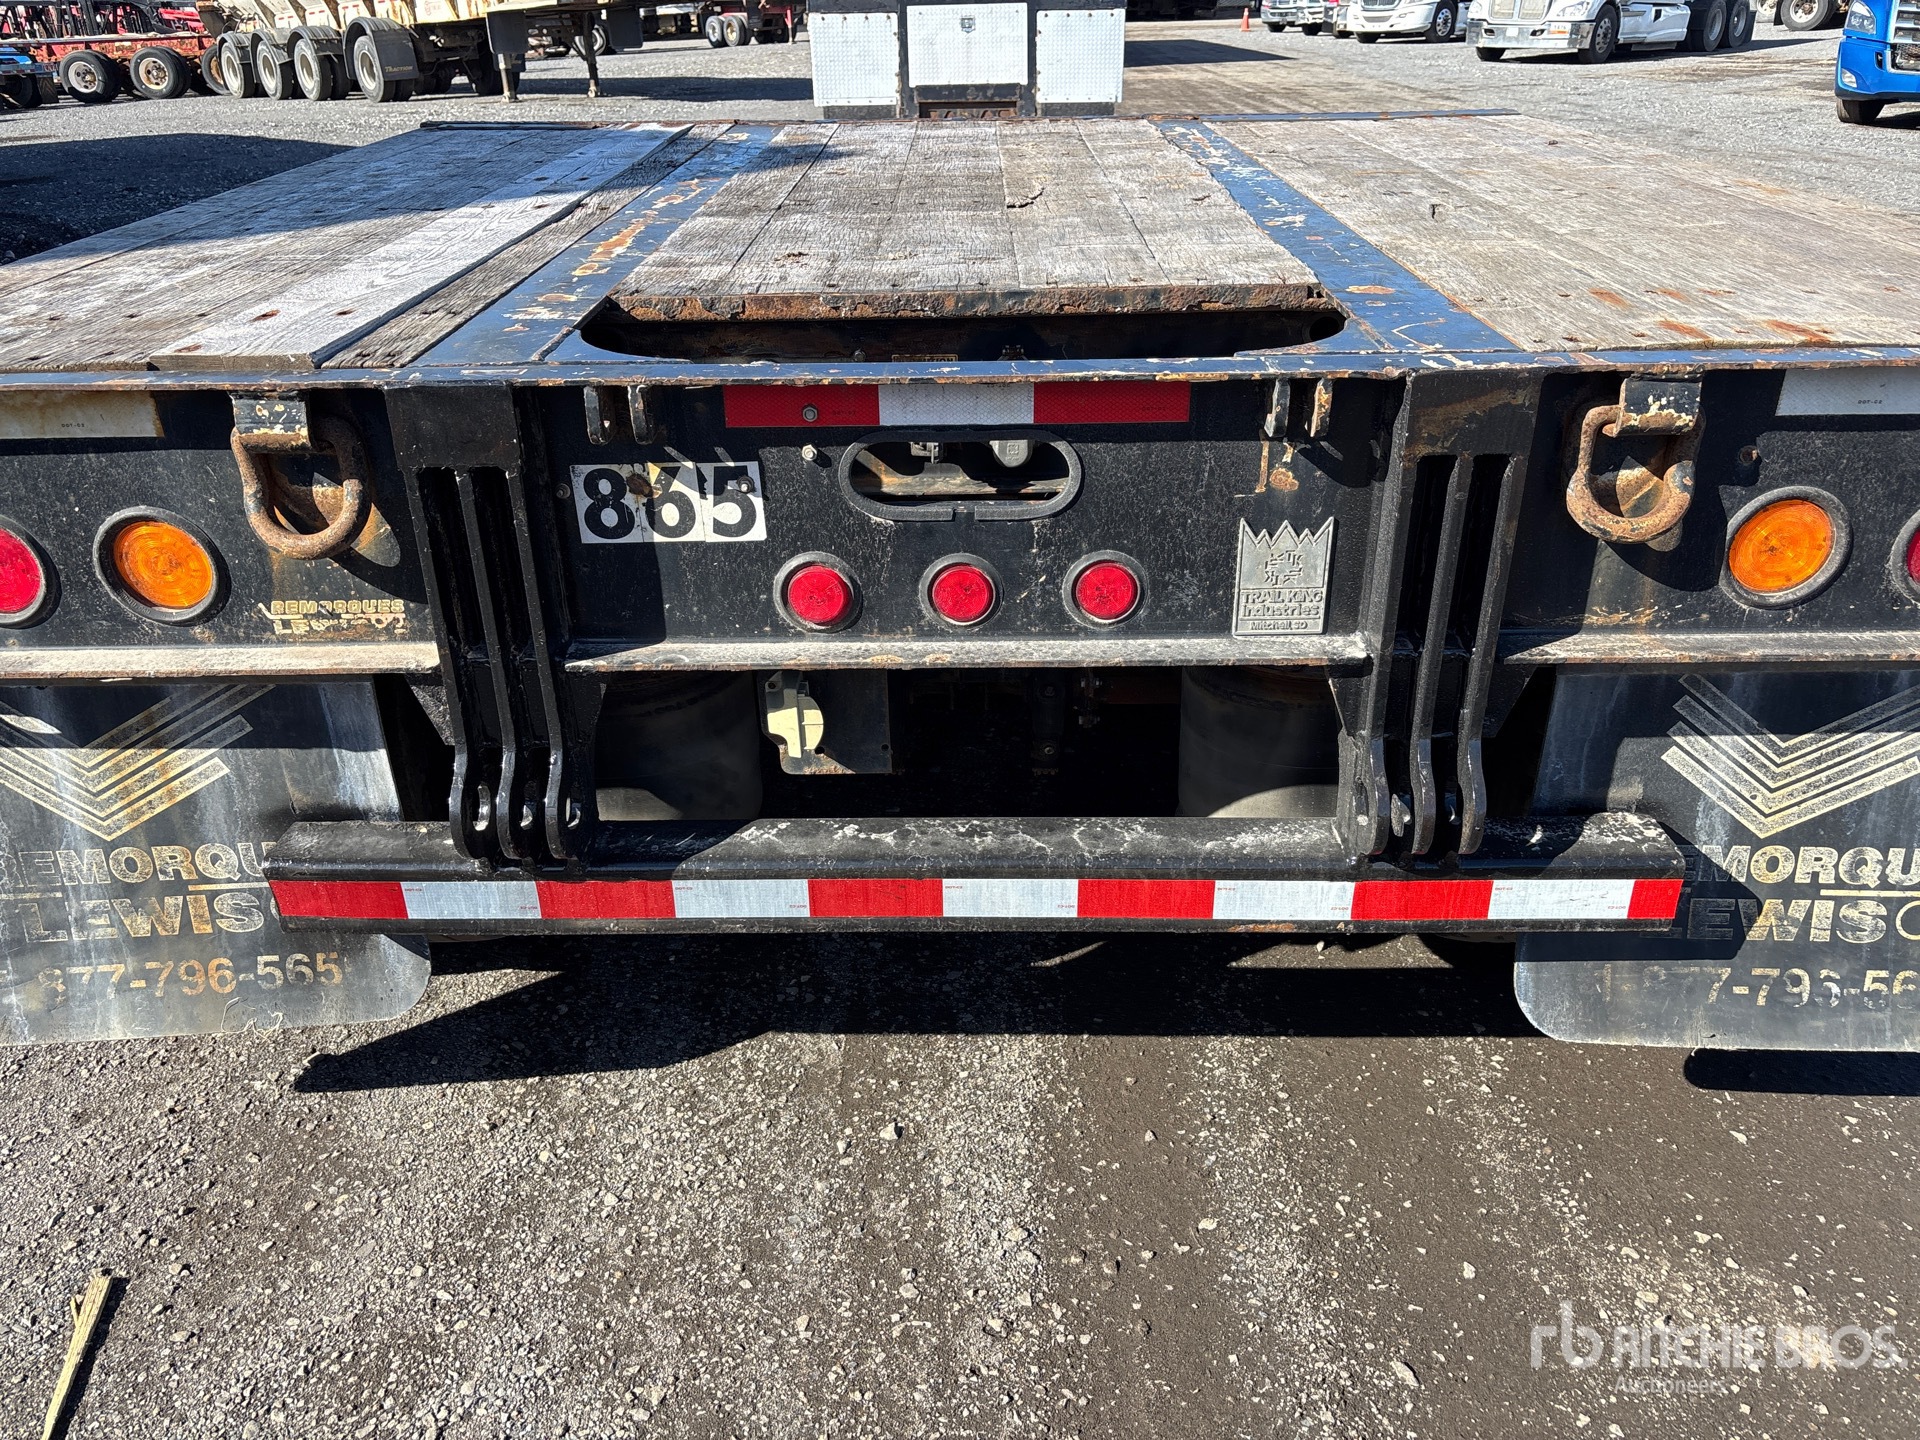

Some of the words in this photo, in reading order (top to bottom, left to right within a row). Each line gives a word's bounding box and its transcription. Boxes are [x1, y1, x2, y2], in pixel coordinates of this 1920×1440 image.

[584, 466, 758, 539] 865
[271, 600, 405, 615] REMORQUES
[1241, 590, 1285, 603] TRAIL
[1287, 589, 1323, 602] KING
[15, 892, 281, 943] LEWIS
